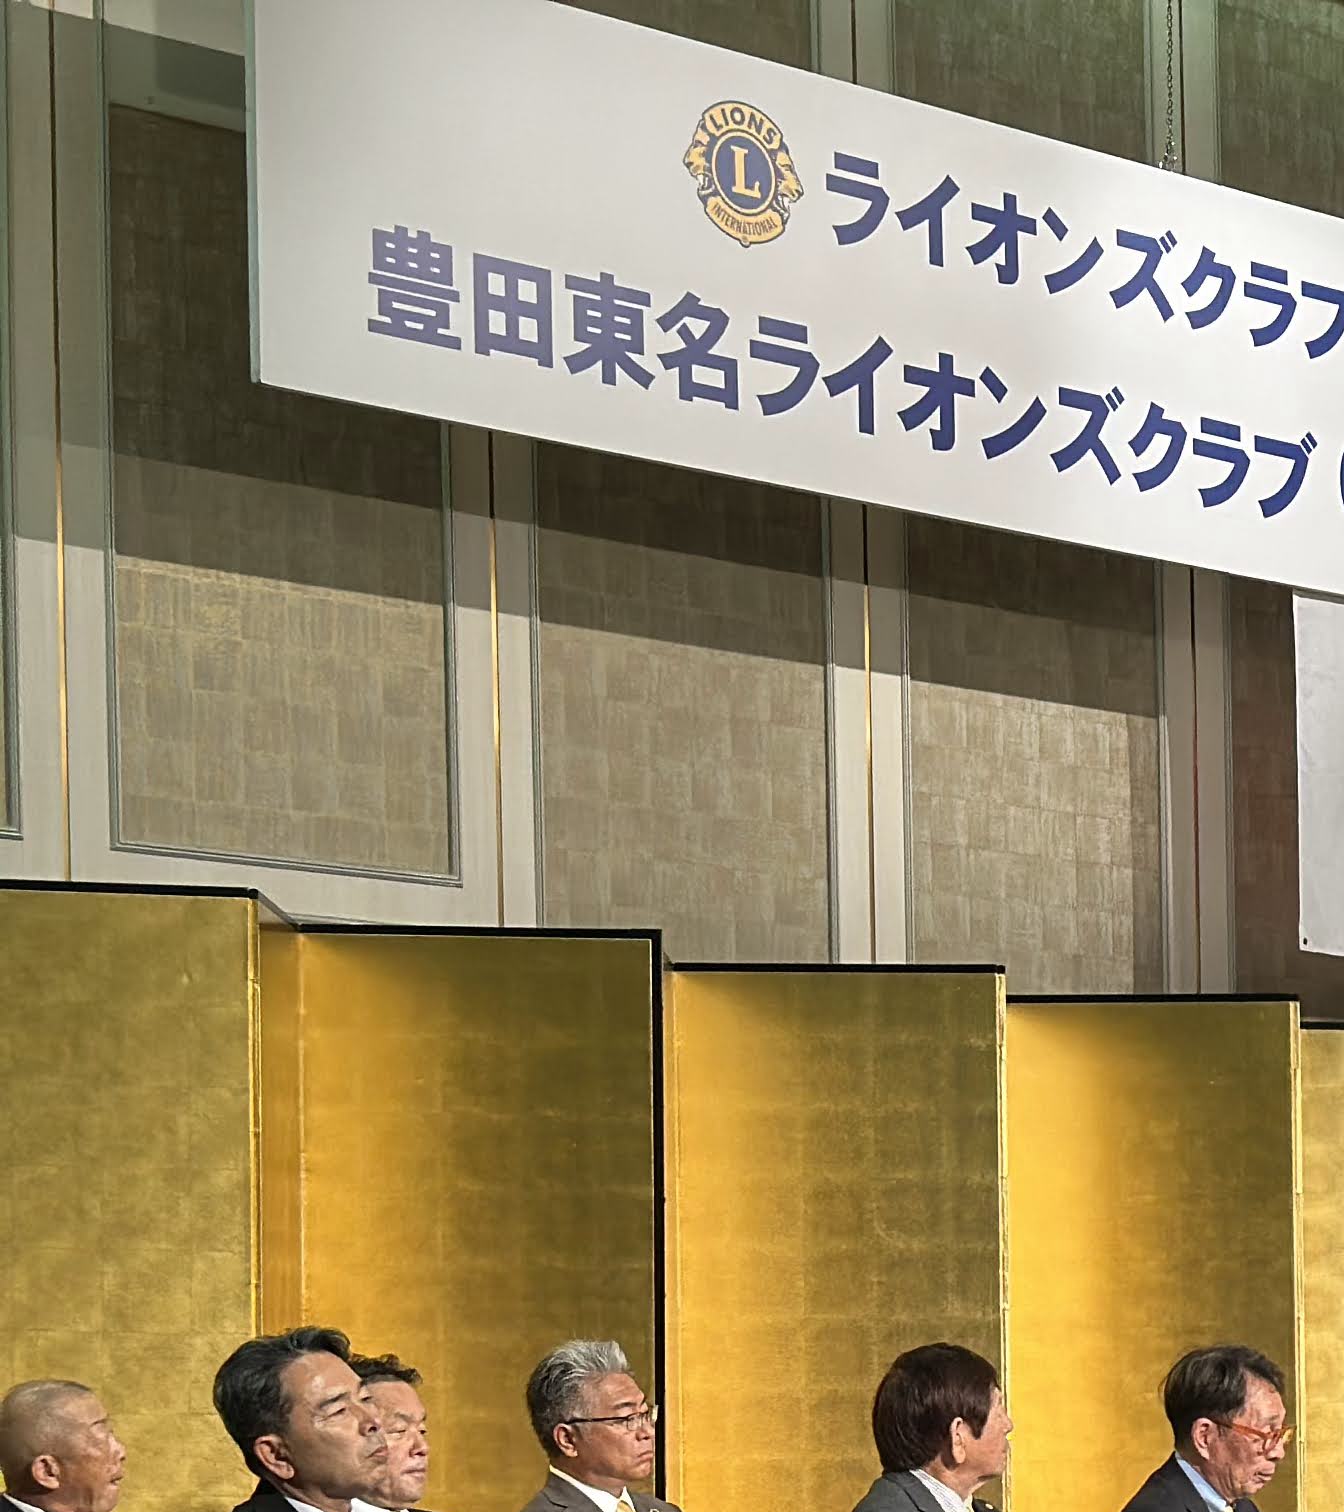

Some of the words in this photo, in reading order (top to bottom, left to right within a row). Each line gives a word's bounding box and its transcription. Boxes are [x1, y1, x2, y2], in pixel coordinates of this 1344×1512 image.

[710, 107, 777, 145] LIONS
[731, 145, 761, 198] L
[713, 203, 778, 235] INTERNATIONAL
[366, 224, 1317, 518] 豊田東名ライオンズクラブ
